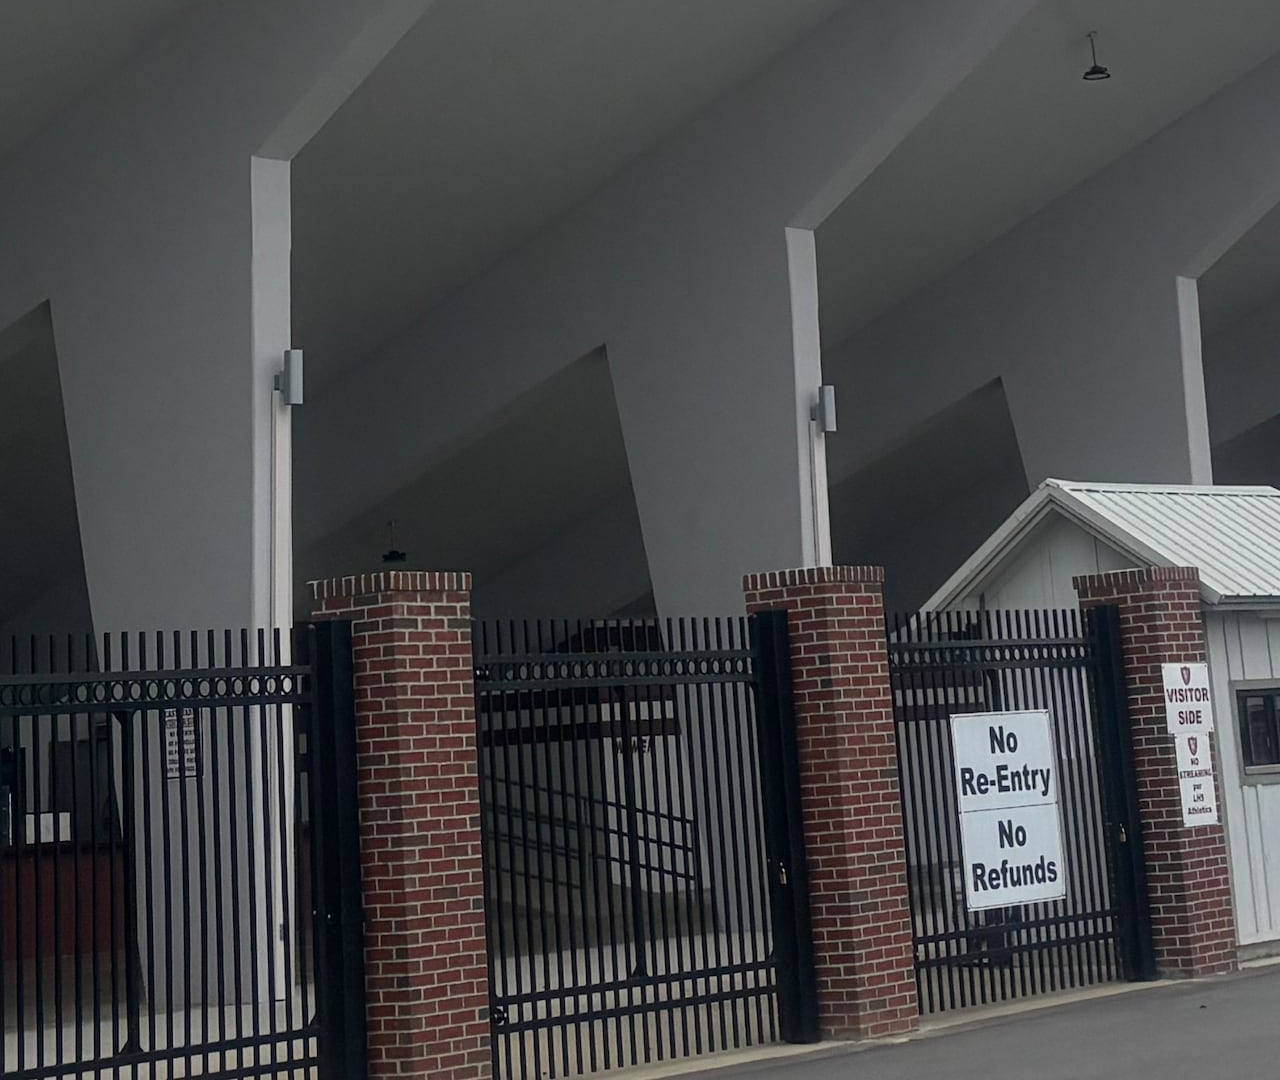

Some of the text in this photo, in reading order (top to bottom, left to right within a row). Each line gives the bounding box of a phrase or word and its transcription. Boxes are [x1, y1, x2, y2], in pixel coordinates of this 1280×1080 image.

[1166, 687, 1209, 703] VISITOR
[1178, 710, 1203, 725] SIDE
[989, 725, 1018, 754] No
[960, 763, 1051, 797] Re-Entry
[998, 819, 1027, 849] No
[972, 855, 1058, 892] Refunds
